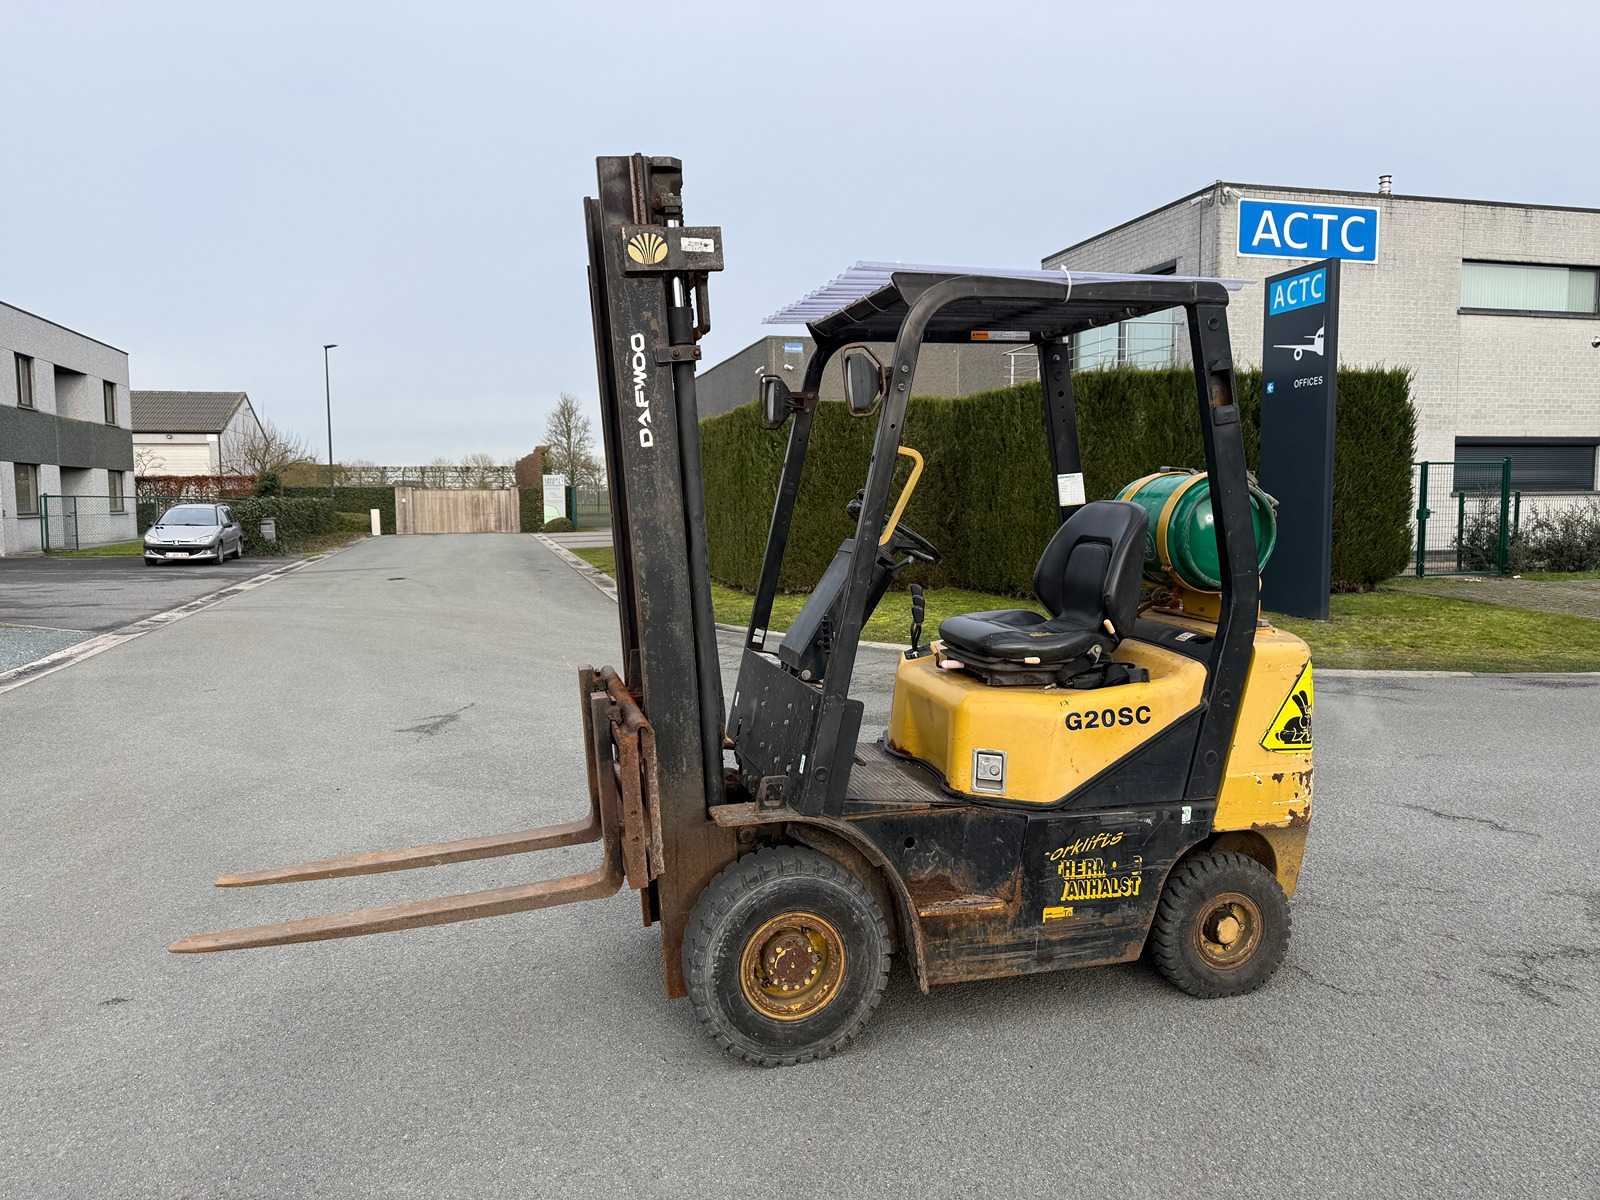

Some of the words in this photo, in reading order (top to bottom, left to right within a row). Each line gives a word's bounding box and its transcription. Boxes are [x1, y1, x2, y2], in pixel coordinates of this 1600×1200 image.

[1252, 210, 1366, 252] ACTC
[1273, 273, 1322, 309] ACTC
[1293, 375, 1323, 388] OFFICES
[1065, 705, 1151, 731] G20SC
[1045, 832, 1124, 861] orklifts
